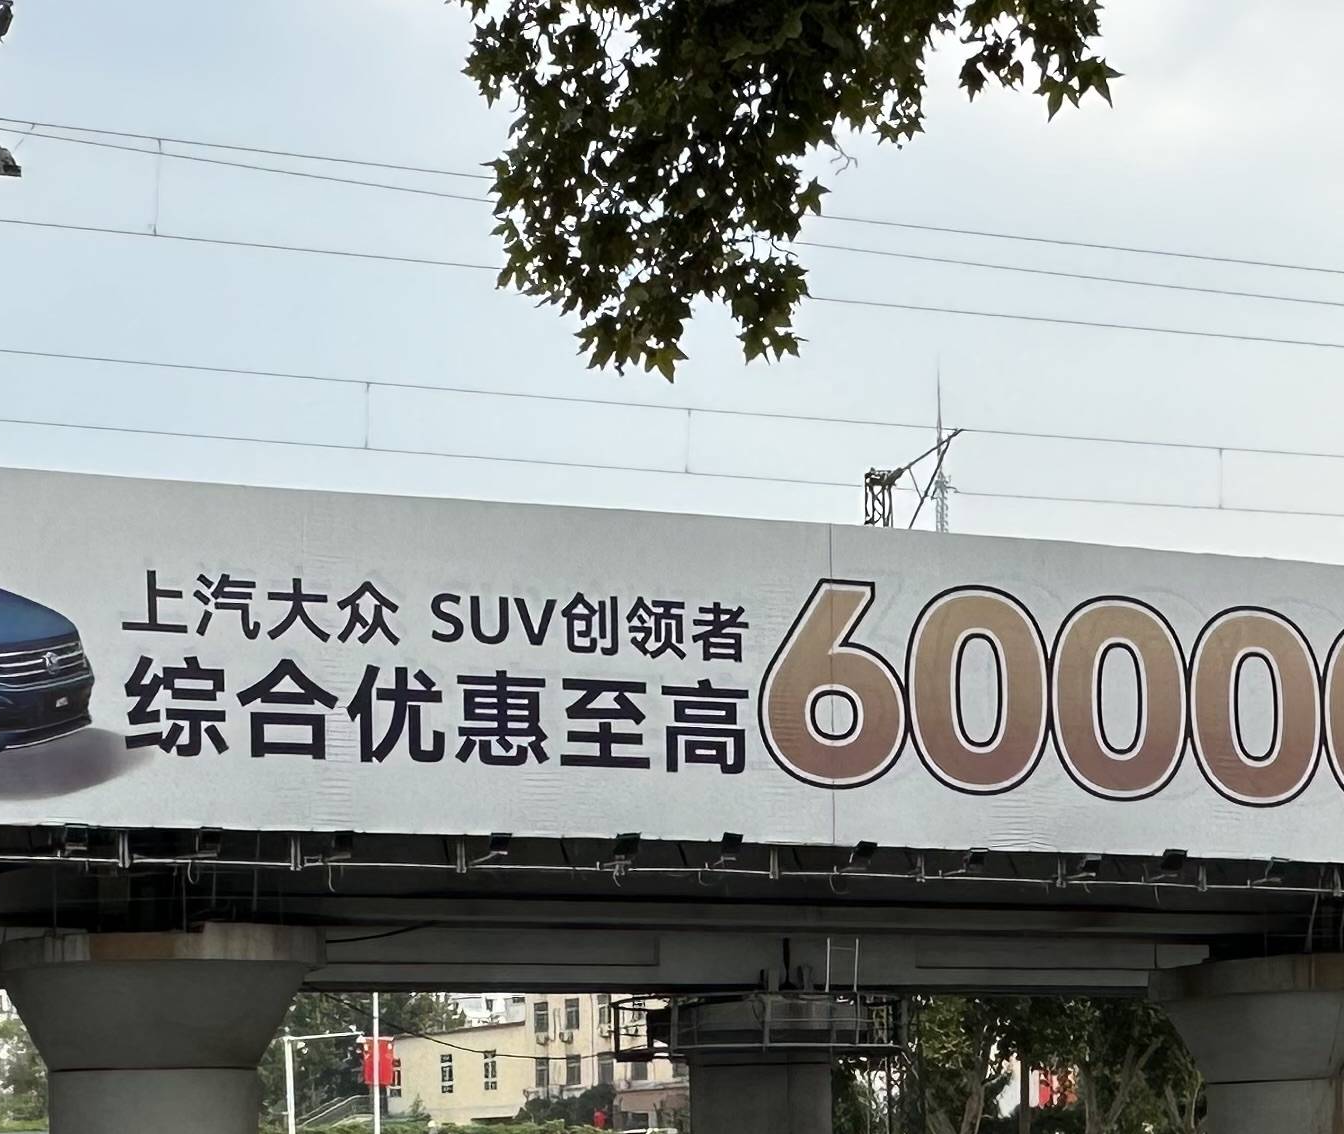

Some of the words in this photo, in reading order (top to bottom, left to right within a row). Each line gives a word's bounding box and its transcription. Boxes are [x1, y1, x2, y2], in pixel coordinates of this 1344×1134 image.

[122, 569, 400, 646] 上汽大众
[123, 654, 750, 775] 综合优惠至高
